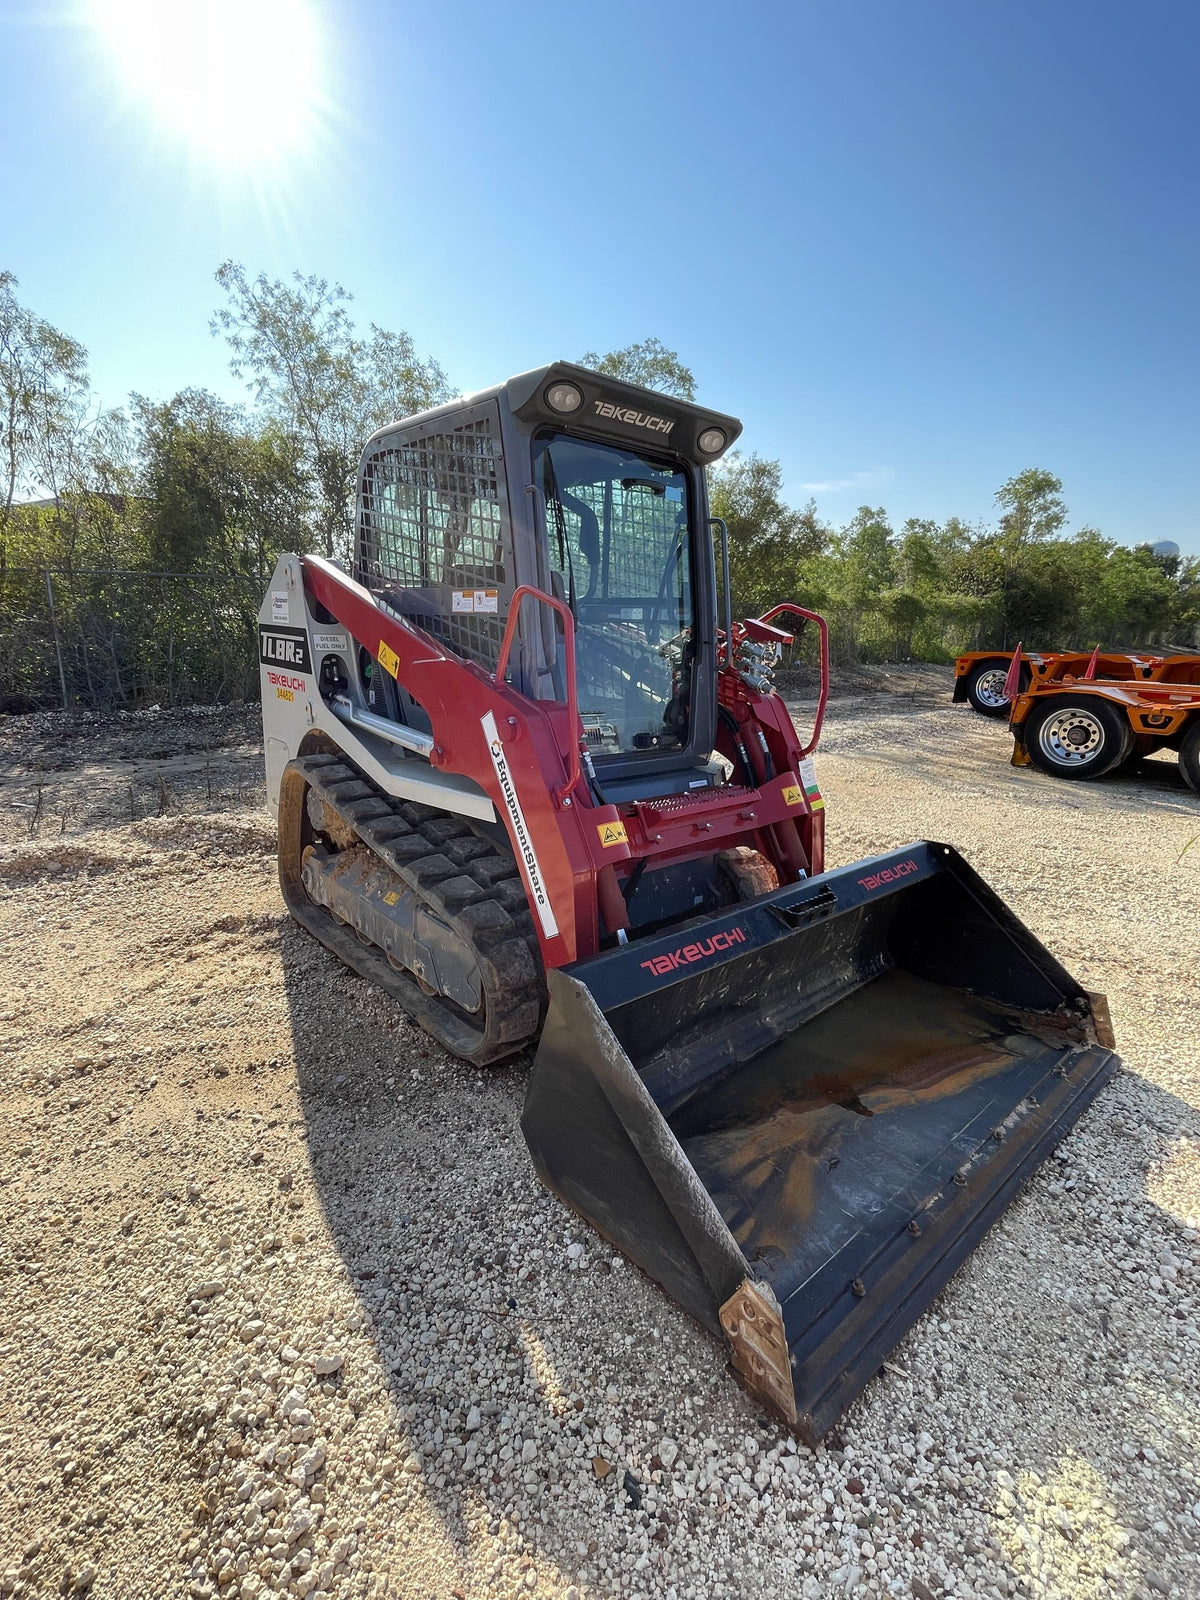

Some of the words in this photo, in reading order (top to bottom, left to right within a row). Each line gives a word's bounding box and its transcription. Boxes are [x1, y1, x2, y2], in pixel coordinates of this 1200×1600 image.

[594, 400, 674, 434] TAKEUCHI
[267, 671, 305, 692] TAKEUCHI
[496, 759, 545, 905] EquipmentShare
[857, 860, 918, 891] TAKEUCHI
[640, 927, 746, 977] TAKEUCHI
